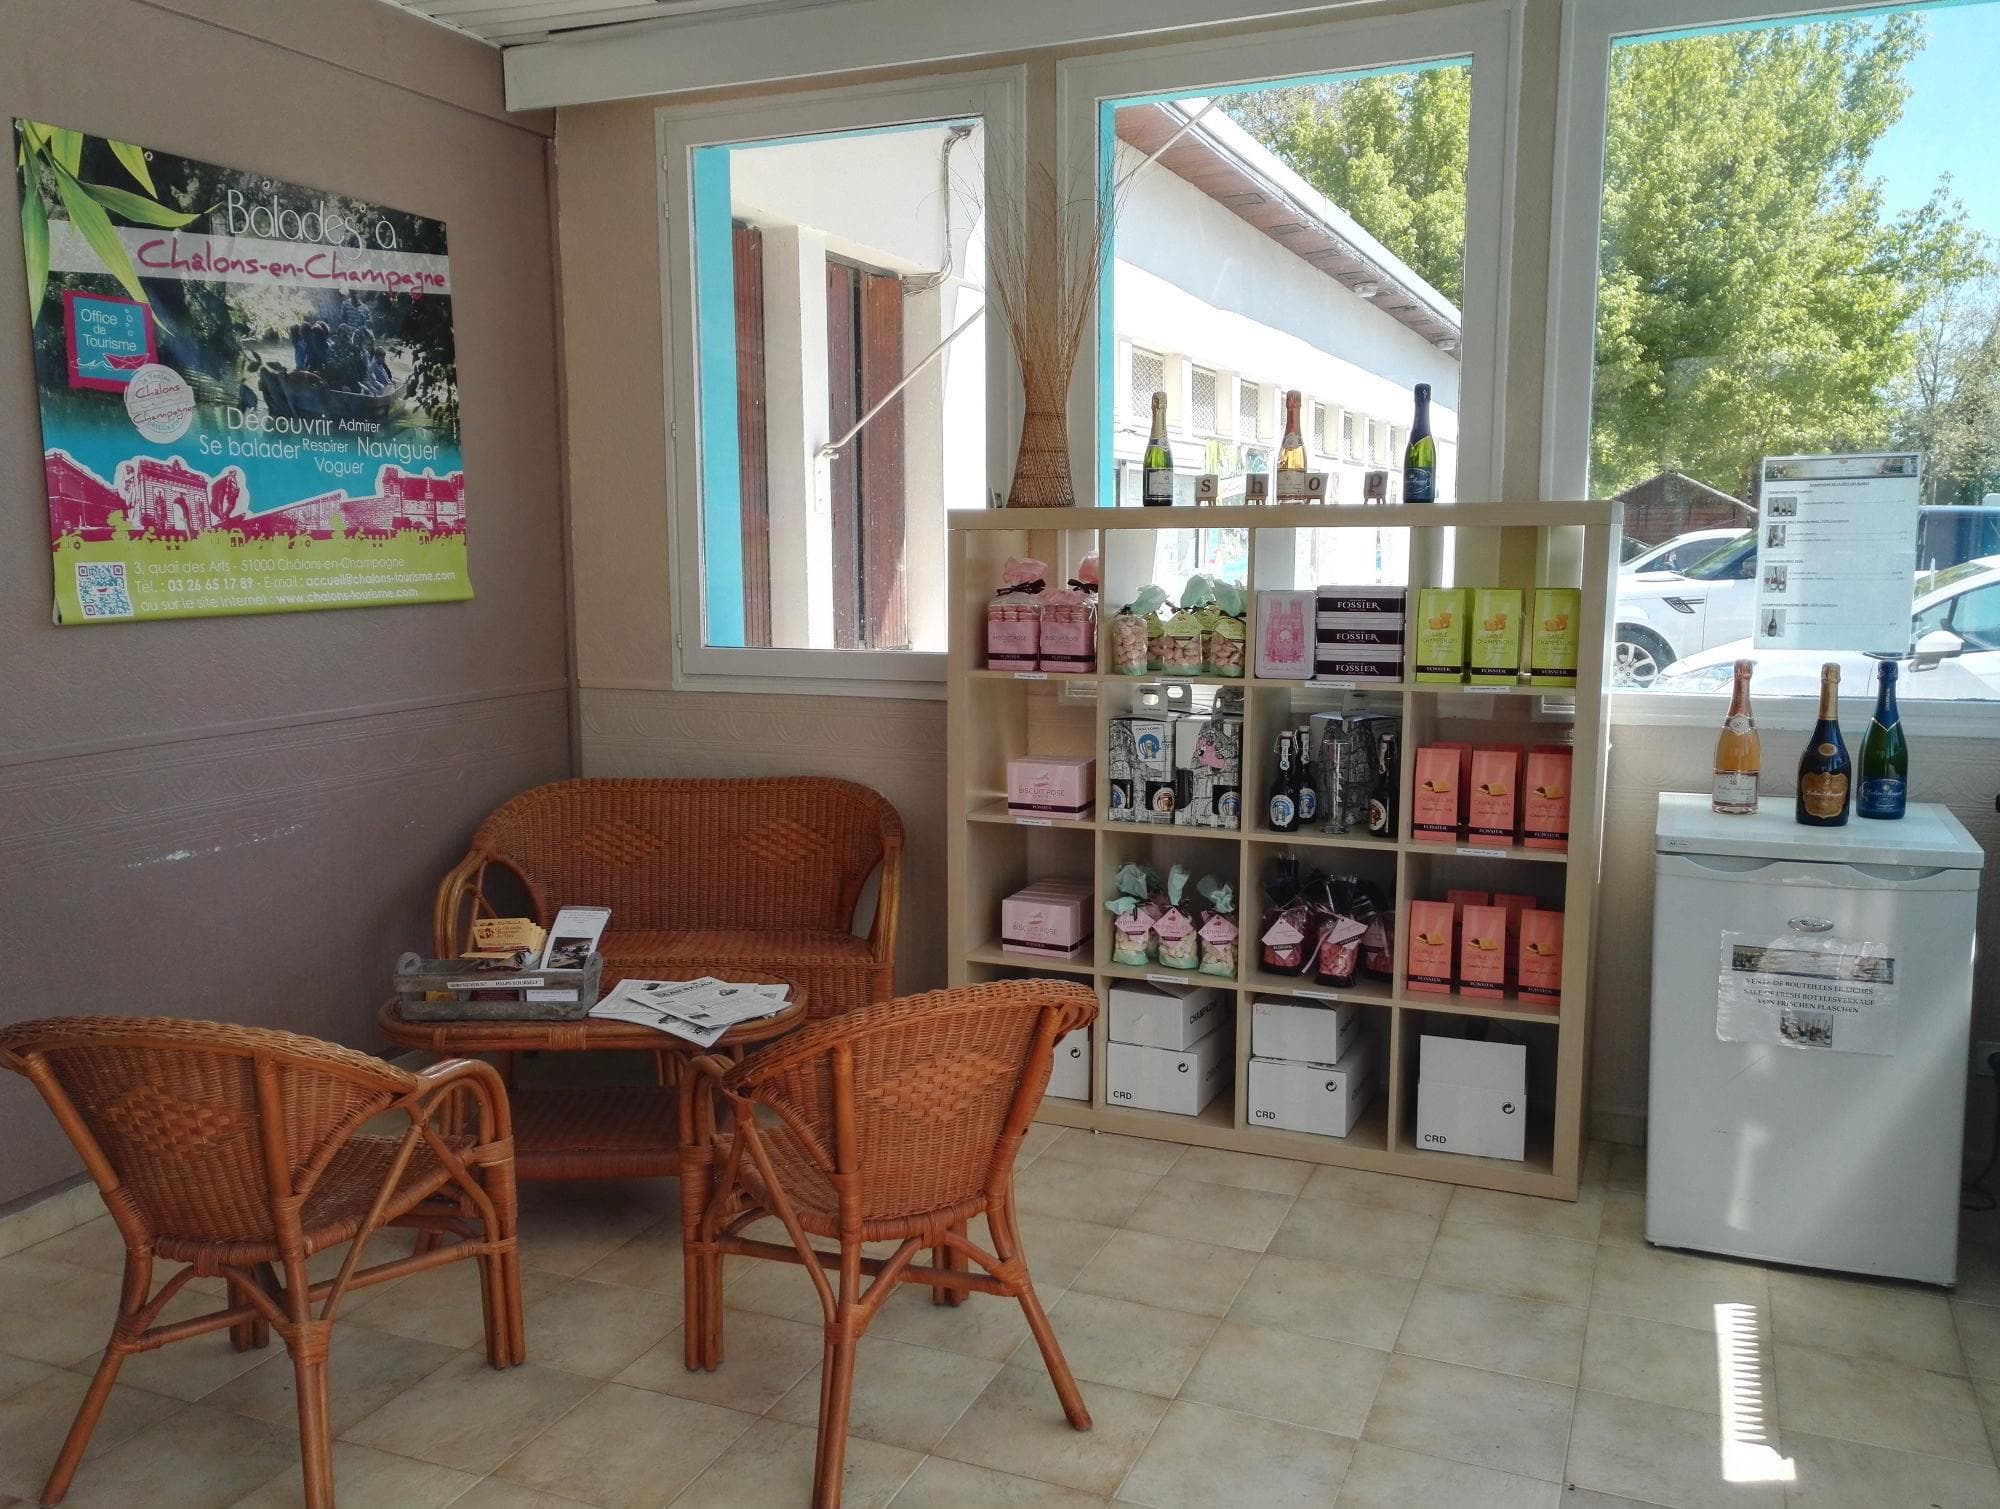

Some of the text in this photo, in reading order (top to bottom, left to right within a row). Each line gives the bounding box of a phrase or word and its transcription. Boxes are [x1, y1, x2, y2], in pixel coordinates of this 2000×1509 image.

[227, 188, 397, 260] Balades à
[136, 235, 446, 300] Châlons-en-Champagne
[81, 308, 118, 325] Office
[93, 325, 106, 335] de
[82, 333, 137, 351] Tourisme
[132, 405, 193, 424] Champagne
[226, 406, 381, 436] Découvrir Admirer
[199, 434, 439, 463] Se balader Respirer Naviguer
[314, 456, 364, 477] Voguer
[133, 561, 146, 574] 3,
[148, 560, 179, 577] quai
[182, 560, 206, 574] des
[209, 560, 231, 572] Arts
[240, 558, 275, 572] 51000
[277, 556, 405, 571] Châlons-en-Champagne
[167, 579, 184, 592] 03
[186, 579, 201, 592] 26
[205, 578, 219, 591] 65
[224, 577, 236, 590] 17
[239, 576, 253, 589] 89
[263, 575, 297, 588] E-mail
[306, 570, 456, 587] accueil@chalons-tourisme.com
[140, 601, 159, 612] ou
[162, 601, 178, 611] sur
[182, 597, 194, 609] le
[198, 596, 218, 608] site
[277, 587, 418, 604] www.chalons-tourisme.com
[1337, 600, 1382, 611] FOSSIER
[1336, 632, 1381, 643] FOSSIER
[1335, 663, 1380, 675] FOSSIER
[1018, 785, 1065, 797] BISCUIT ROSE
[1785, 981, 1833, 992] BOUTEILLES
[1776, 991, 1800, 1000] FRESH
[1777, 999, 1816, 1010] FRISCHEN
[1817, 1004, 1859, 1014] FLASCHEN
[1113, 1090, 1132, 1100] CRD
[1255, 1109, 1276, 1120] CRD
[1424, 1133, 1447, 1144] CRD
